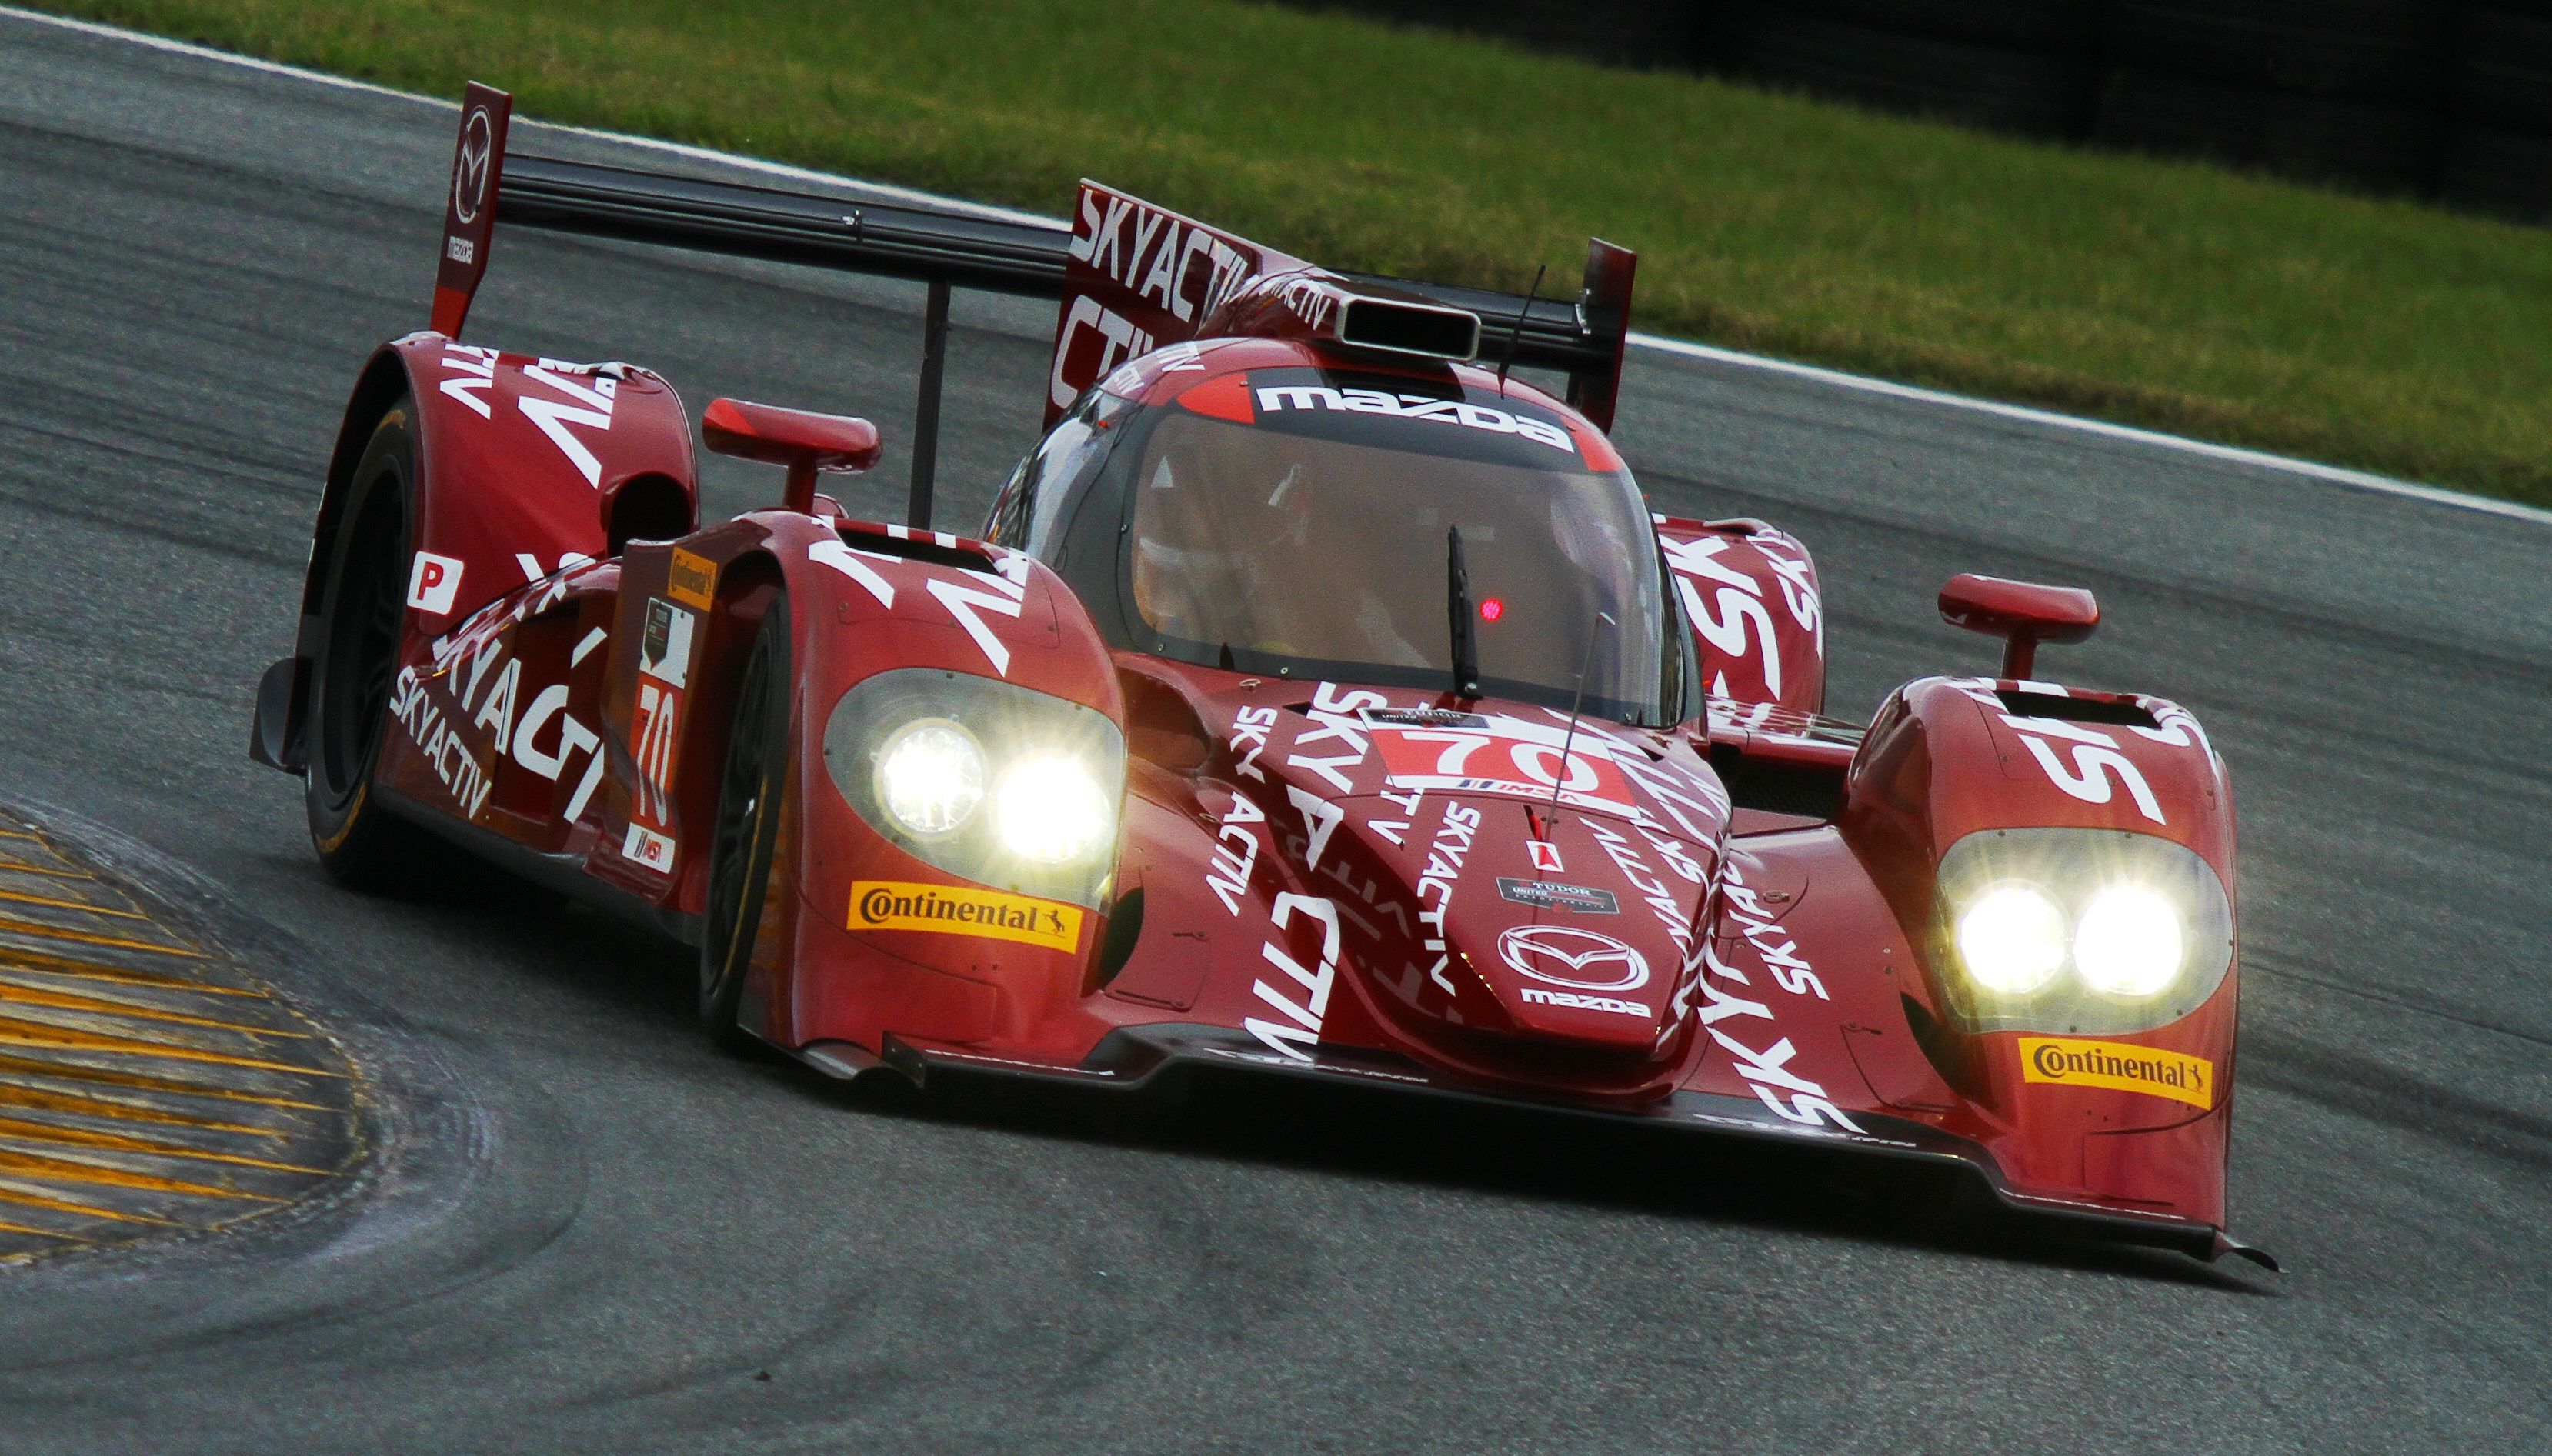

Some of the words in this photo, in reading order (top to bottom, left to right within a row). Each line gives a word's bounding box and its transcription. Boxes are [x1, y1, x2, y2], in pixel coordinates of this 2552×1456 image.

[417, 561, 444, 601] P
[390, 666, 492, 819] SKYACTIV
[637, 684, 674, 827] 70
[1402, 731, 1599, 792] 70
[860, 888, 1038, 932] Continental
[1417, 801, 1481, 997] SKYACTIV
[1533, 882, 1592, 896] TUDOR
[2033, 1043, 2188, 1089] Continental
